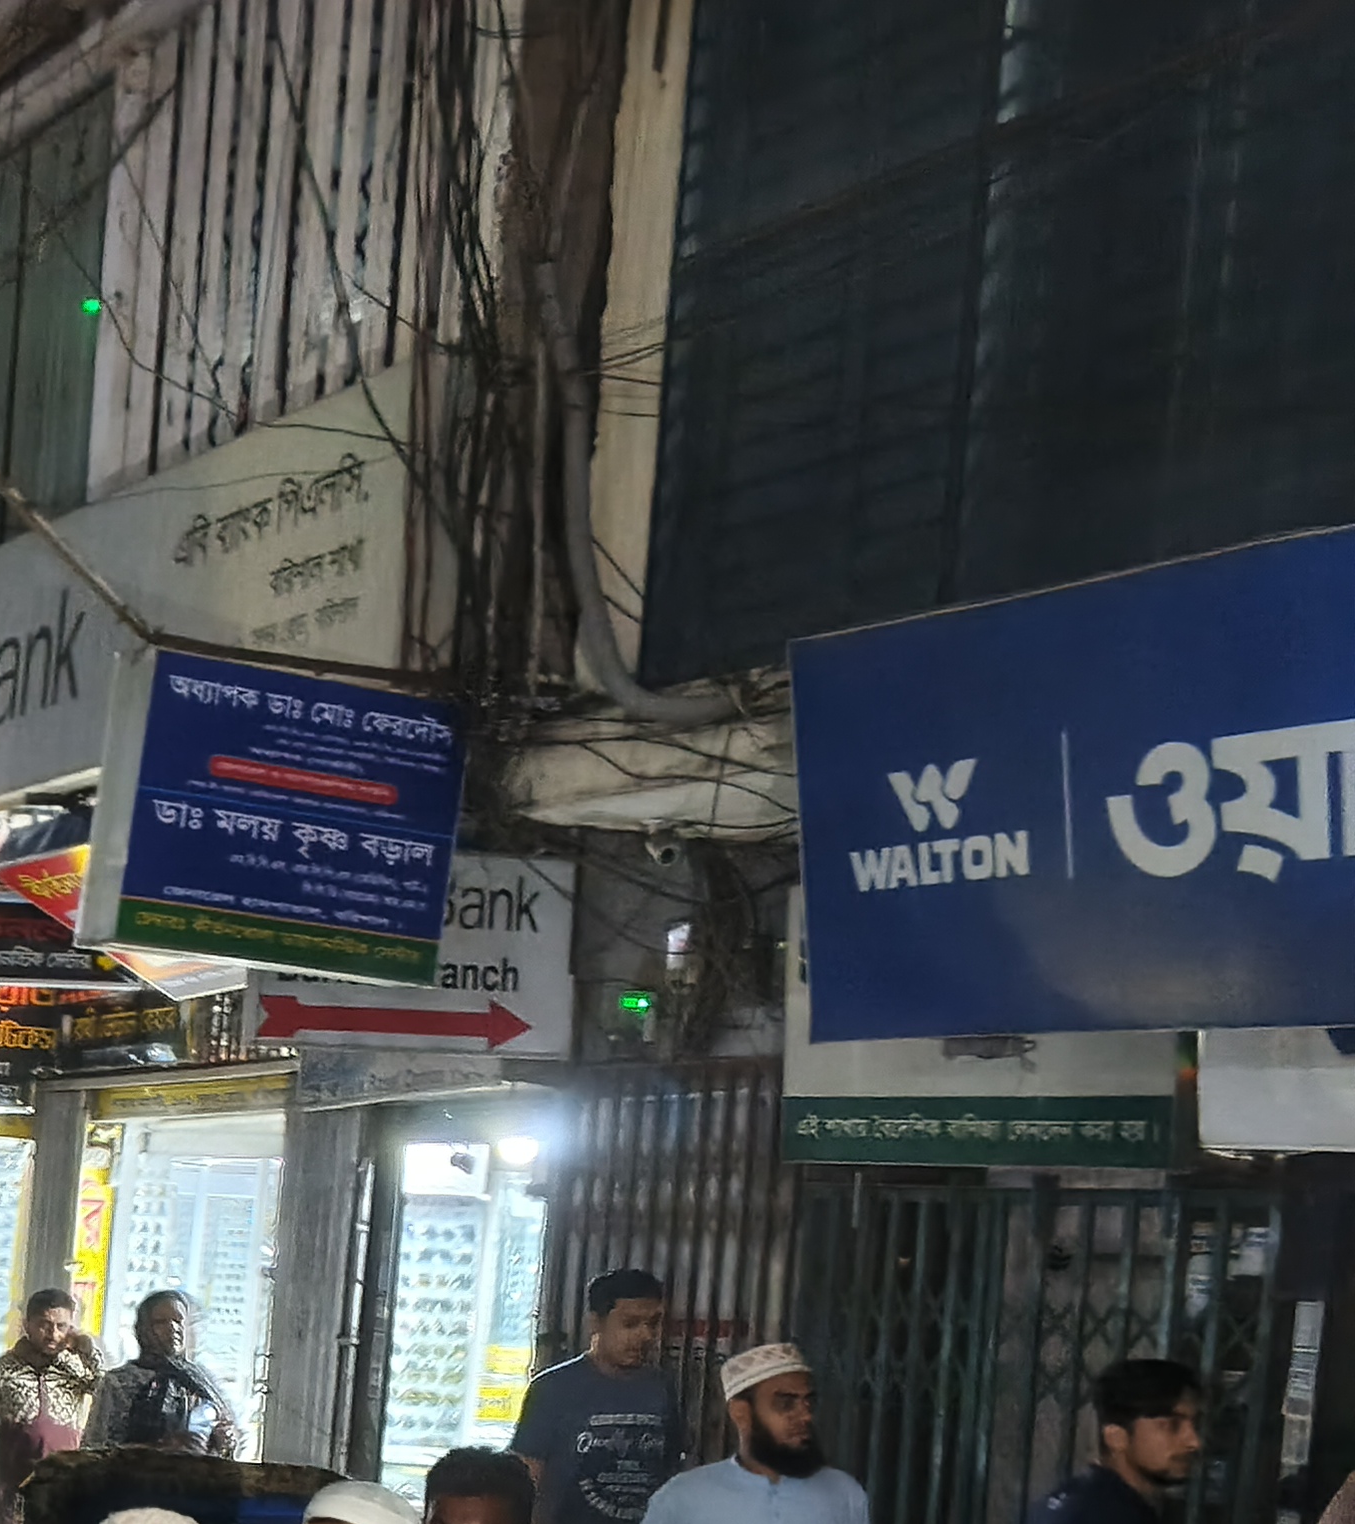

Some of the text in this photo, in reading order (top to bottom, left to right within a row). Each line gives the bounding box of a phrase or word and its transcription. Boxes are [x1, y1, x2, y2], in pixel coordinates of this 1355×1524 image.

[168, 673, 261, 709] অধ্যাপক
[266, 691, 304, 720] ডাঃ
[1105, 718, 1355, 883] ওয়া
[152, 798, 204, 831] ডাঃ
[213, 807, 283, 843] মলয়
[360, 832, 436, 867] বড়াল
[849, 830, 1030, 892] WALTON
[441, 956, 520, 993] anch
